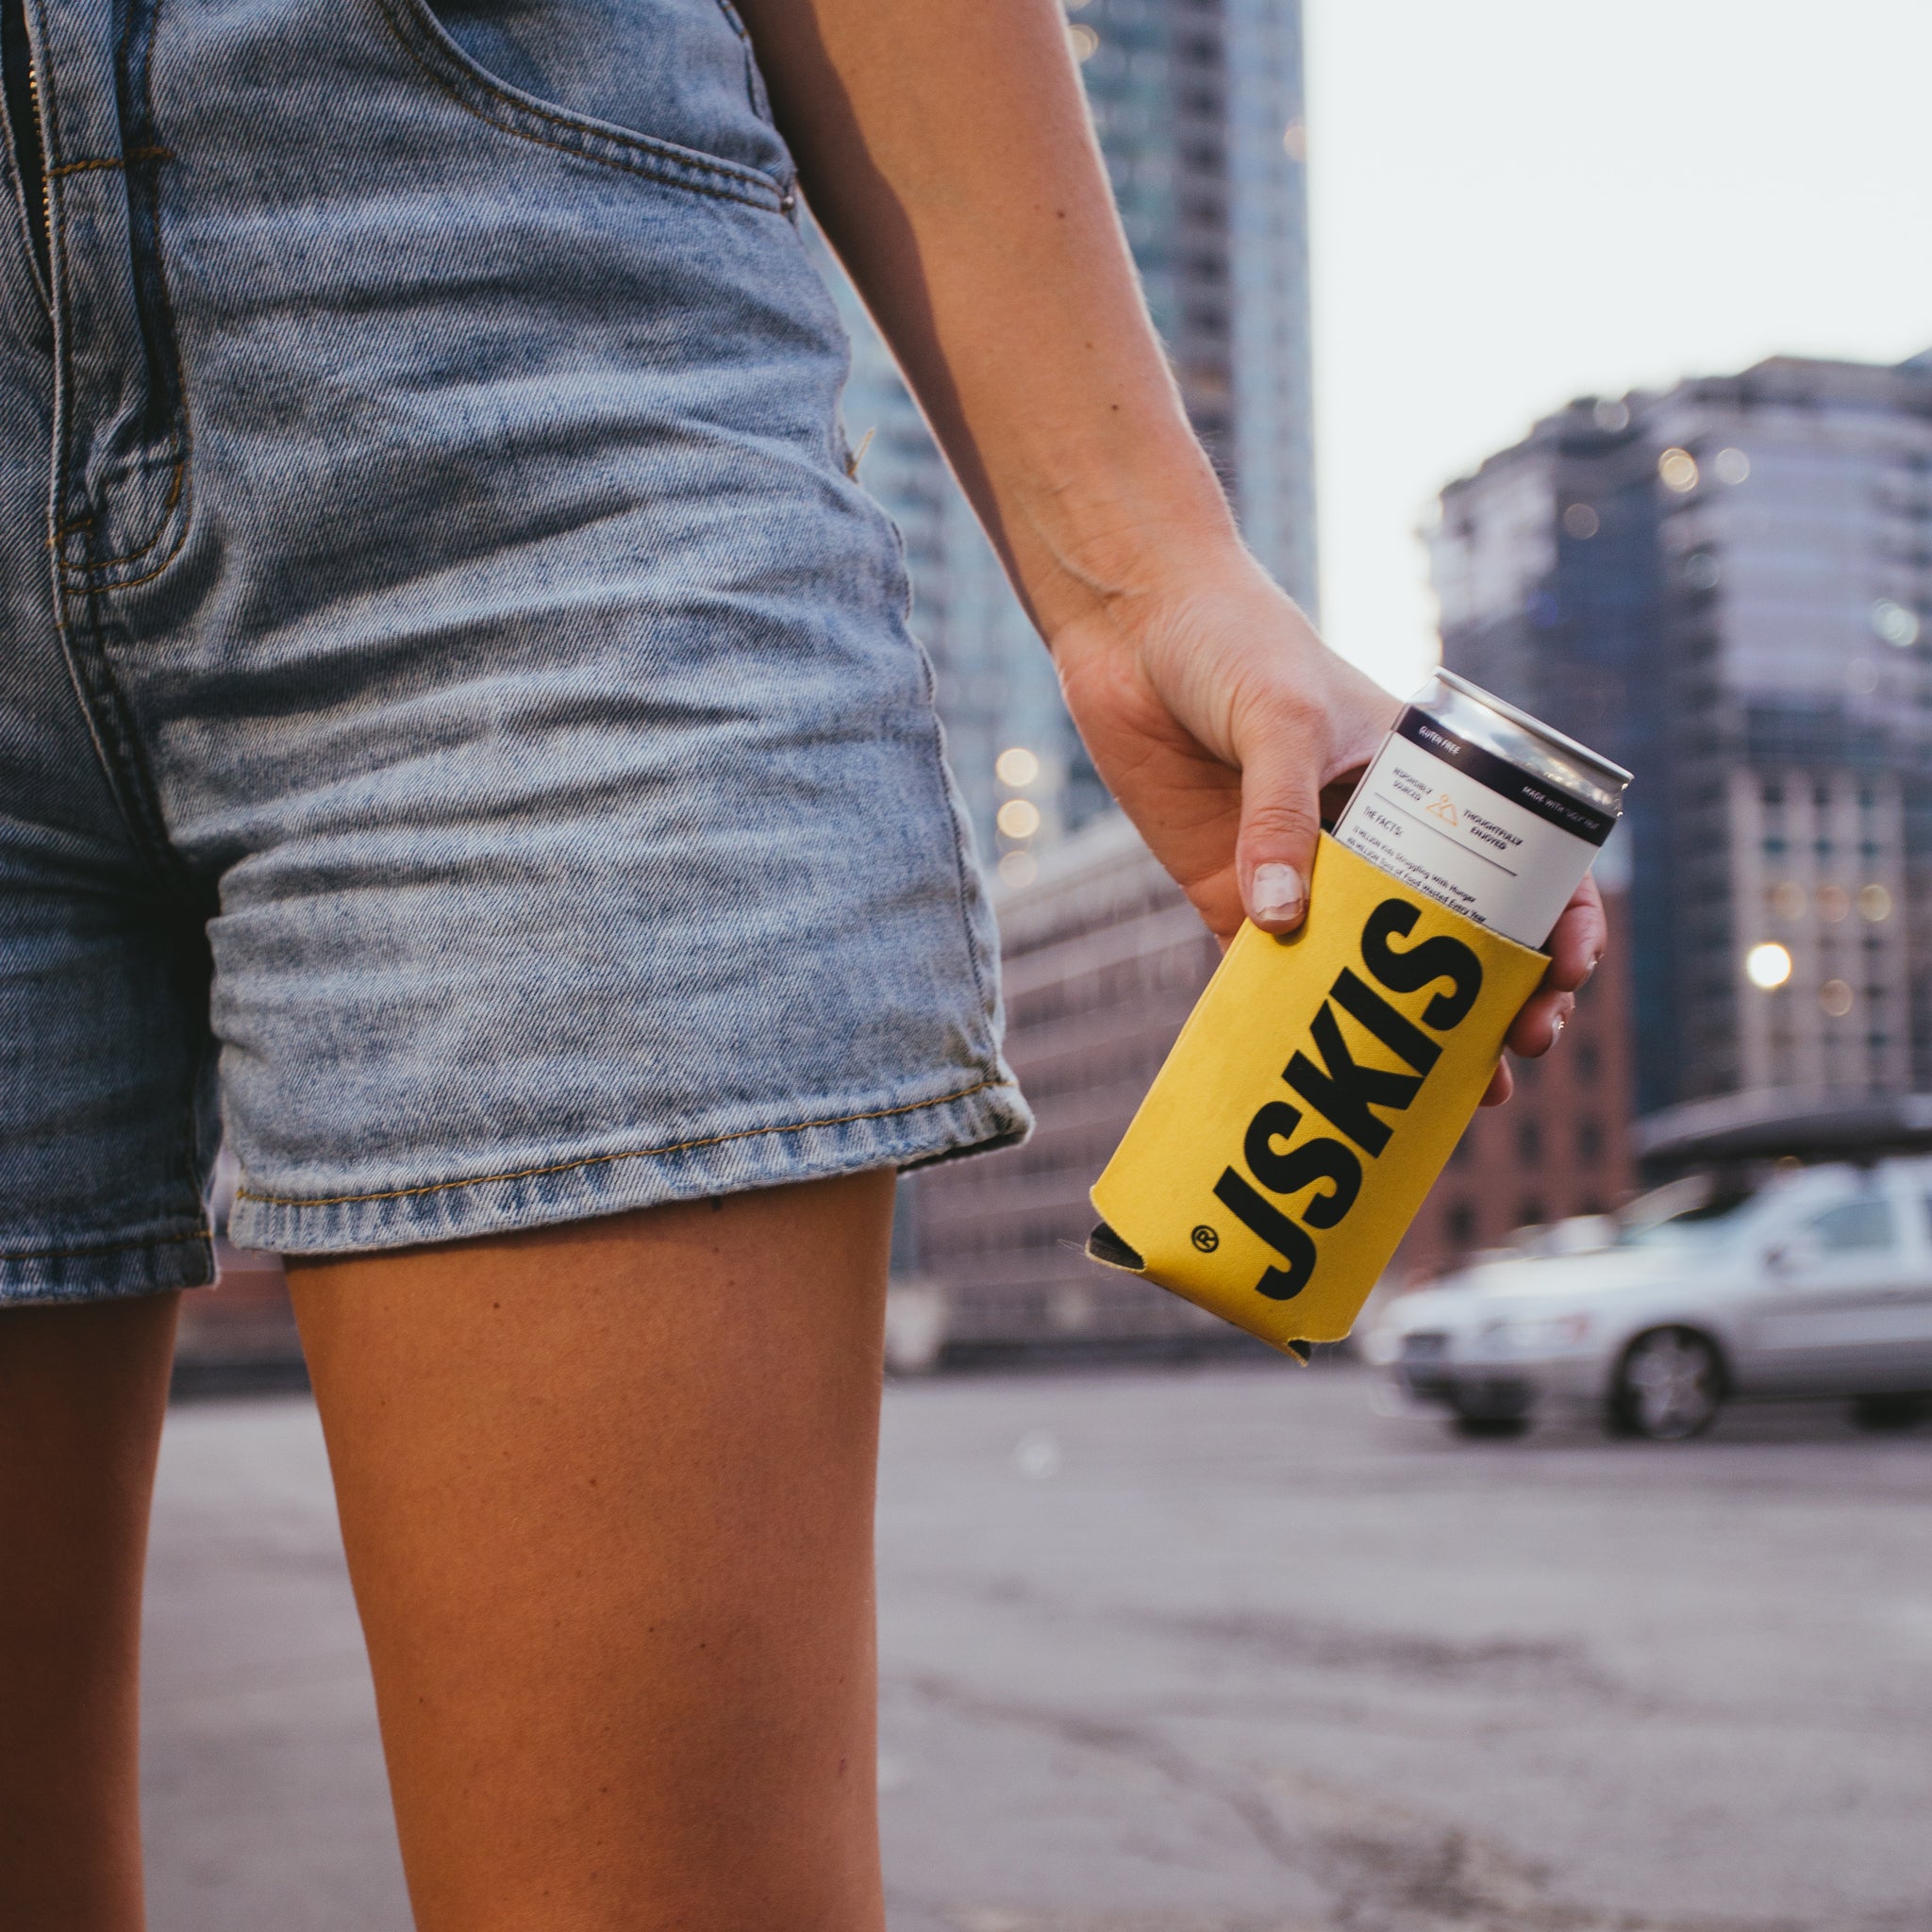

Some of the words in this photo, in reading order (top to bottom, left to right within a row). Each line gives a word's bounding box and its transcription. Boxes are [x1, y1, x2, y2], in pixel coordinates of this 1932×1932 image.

[1440, 739, 1460, 755] FREE
[1522, 785, 1545, 802] MADE
[1362, 807, 1377, 819] THE
[1374, 814, 1405, 836] FACTS:
[1462, 808, 1523, 846] THOUGHTFULLY
[1469, 825, 1507, 850] ENJOYED
[1393, 853, 1431, 878] Struggling
[1431, 874, 1449, 887] With
[1447, 884, 1476, 904] Hunger
[1403, 873, 1422, 886] Food
[1422, 883, 1449, 902] Wasted
[1448, 898, 1470, 915] Every
[1213, 898, 1483, 1301] JSKIS
